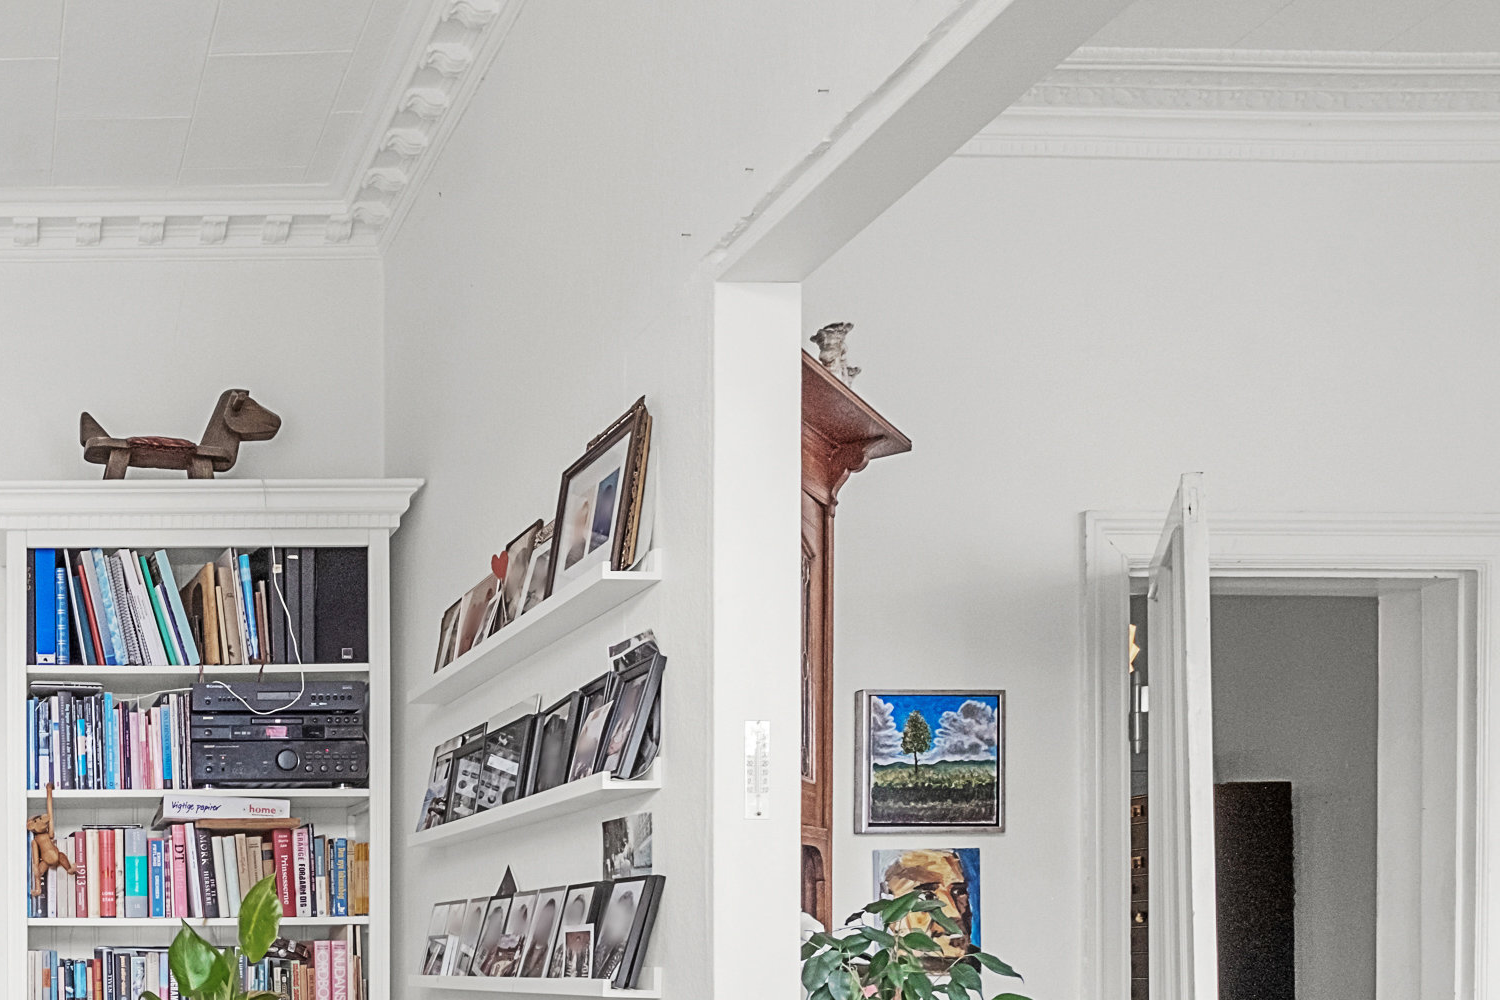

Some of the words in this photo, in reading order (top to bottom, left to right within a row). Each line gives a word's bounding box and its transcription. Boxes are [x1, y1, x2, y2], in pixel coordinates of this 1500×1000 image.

[171, 801, 194, 814] Vigtige
[249, 804, 276, 815] home
[174, 843, 185, 864] DT
[297, 832, 305, 861] GRANGE
[76, 864, 86, 886] 1913
[280, 854, 290, 905] Prinsesserne
[203, 870, 212, 906] HERSKERE
